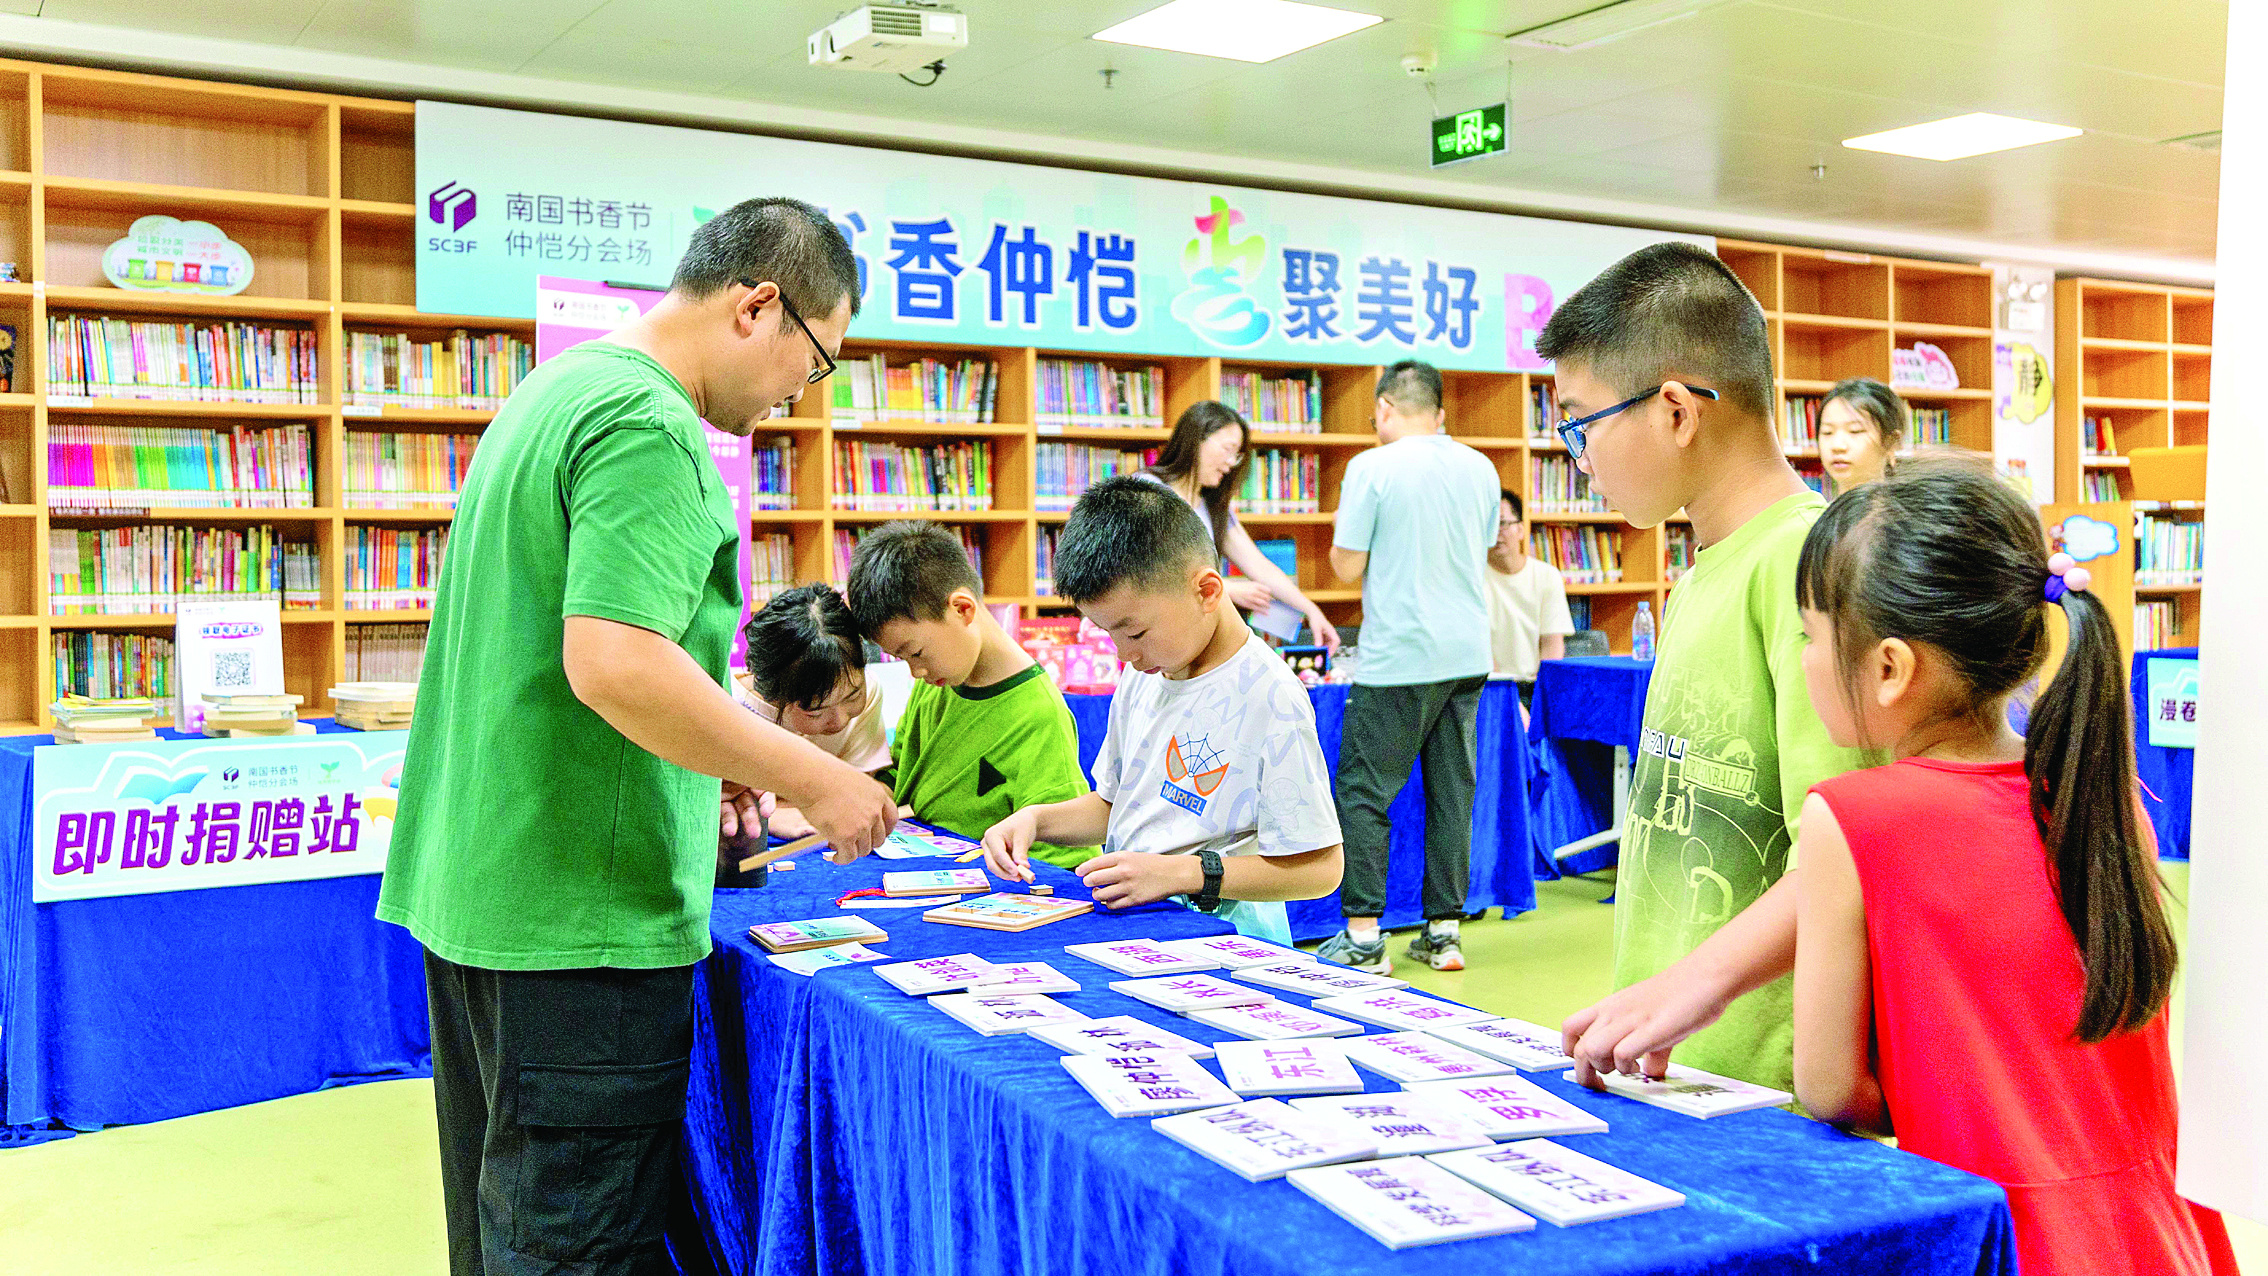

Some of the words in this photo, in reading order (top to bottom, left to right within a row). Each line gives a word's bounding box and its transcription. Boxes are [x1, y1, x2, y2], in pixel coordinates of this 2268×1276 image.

[506, 192, 652, 230] 南国书香节
[505, 230, 652, 266] 仲恺分会场
[2159, 698, 2197, 723] 漫卷
[248, 765, 298, 777] 南国书香节
[1163, 784, 1203, 814] MARVEL
[52, 792, 362, 876] 即时捐赠站
[1107, 944, 1184, 964] 西湖
[1105, 1056, 1201, 1100] 廖仲恺
[1262, 1046, 1325, 1079] 东江
[1457, 1085, 1561, 1121] 罗浮
[1200, 1108, 1327, 1159] 东江纵队
[1476, 1146, 1629, 1205] 东江纵队
